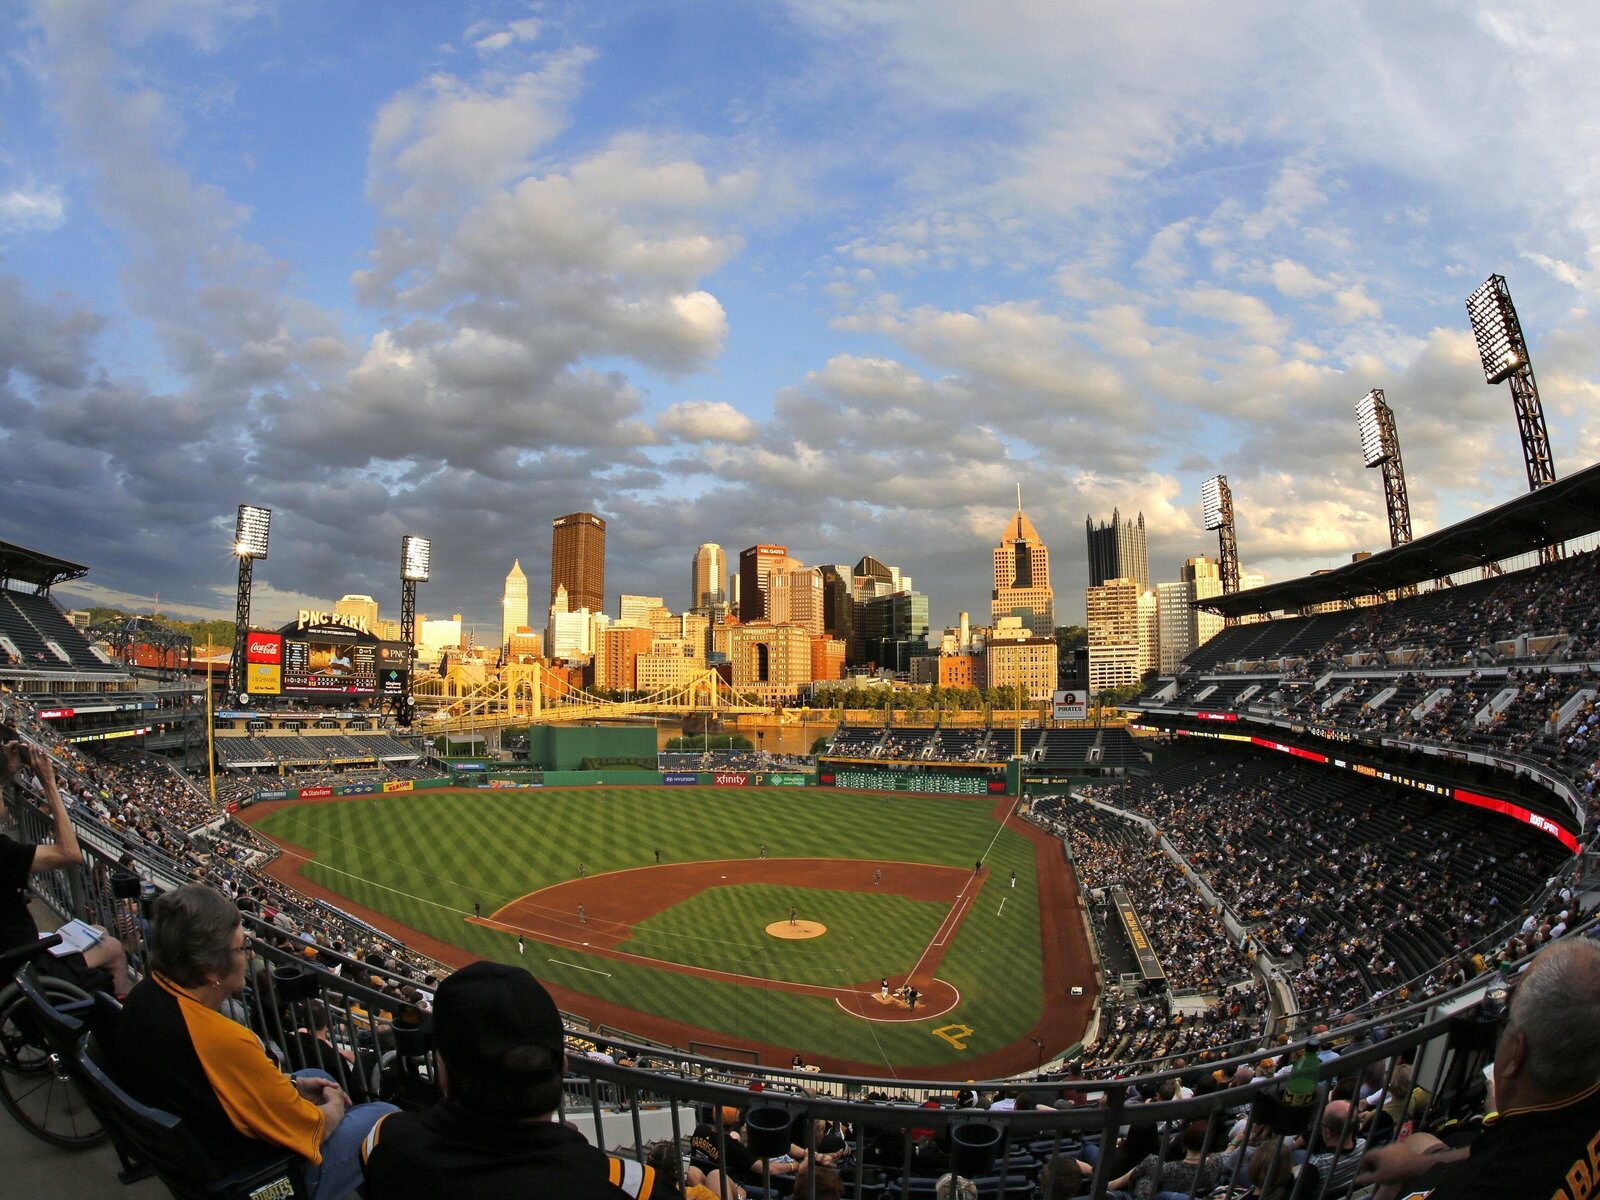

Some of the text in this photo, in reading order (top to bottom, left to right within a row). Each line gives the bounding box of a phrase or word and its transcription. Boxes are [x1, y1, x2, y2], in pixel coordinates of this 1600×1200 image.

[297, 609, 370, 636] PNC PARK
[390, 650, 406, 658] PNC
[716, 774, 746, 785] xfinity
[755, 775, 763, 785] P
[1530, 812, 1544, 828] ROOT
[932, 1023, 975, 1051] P
